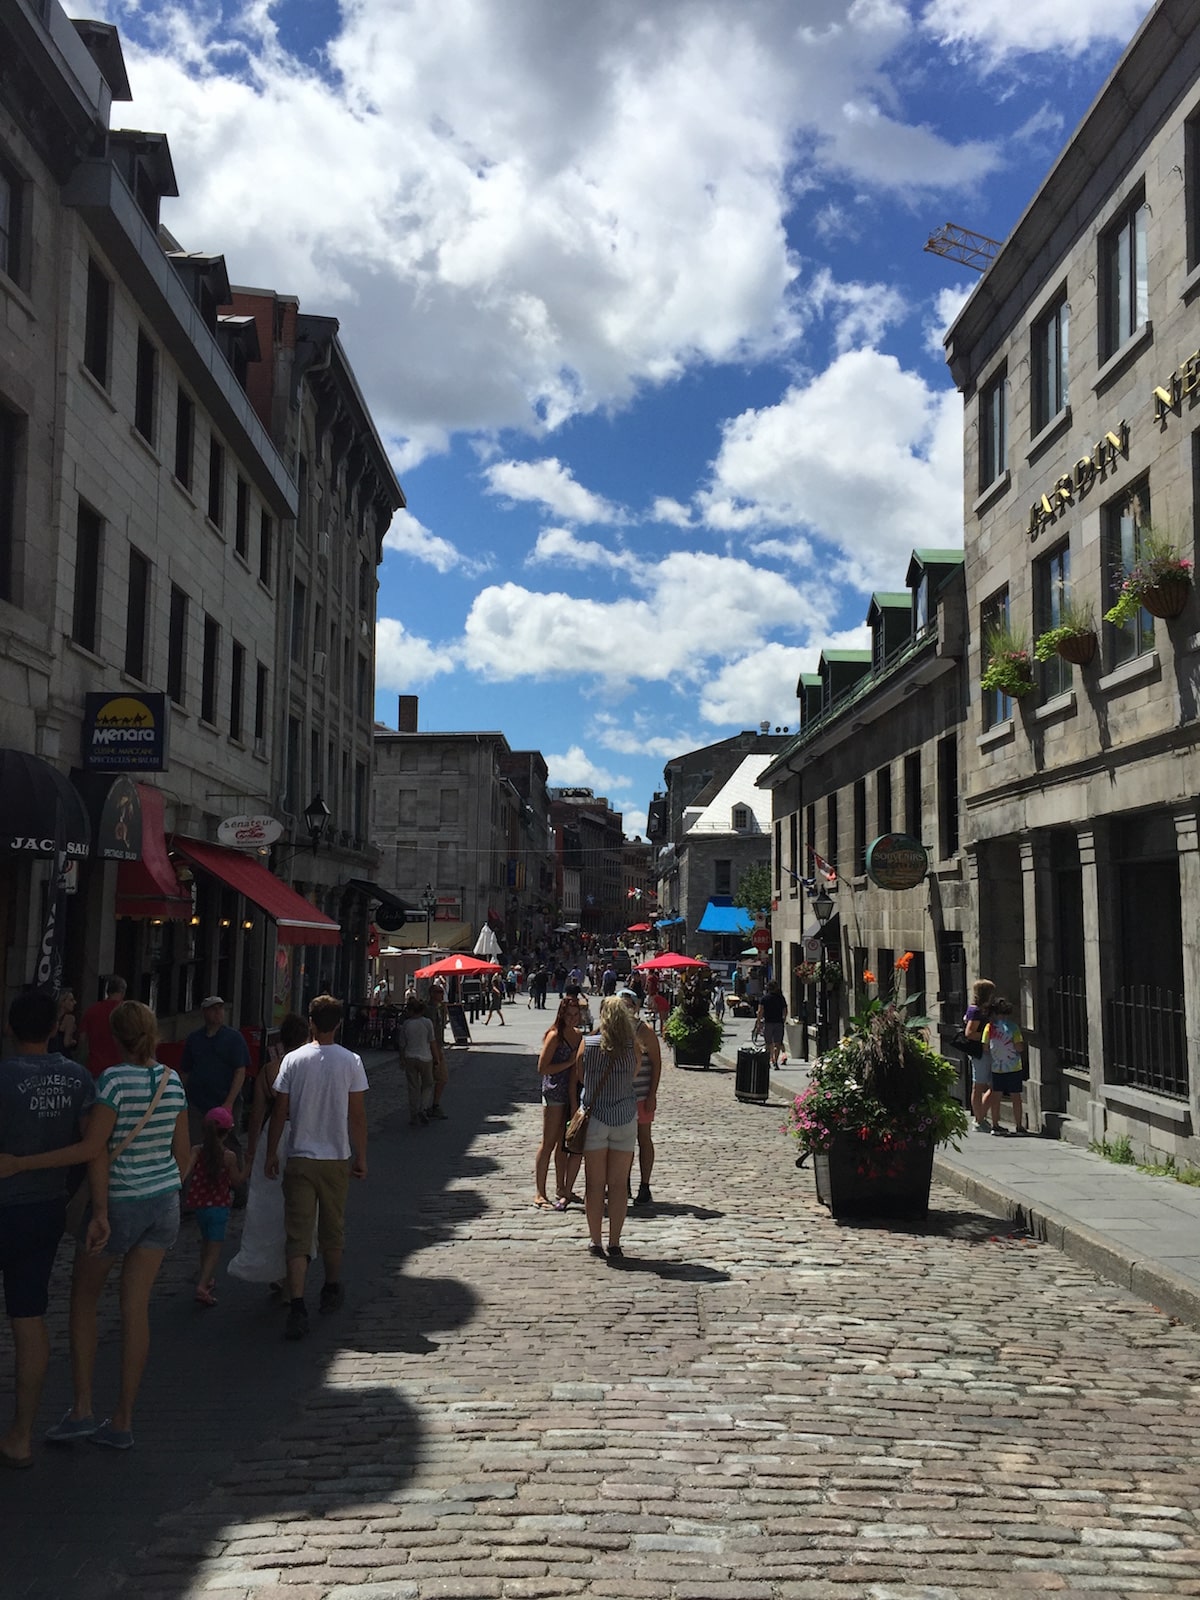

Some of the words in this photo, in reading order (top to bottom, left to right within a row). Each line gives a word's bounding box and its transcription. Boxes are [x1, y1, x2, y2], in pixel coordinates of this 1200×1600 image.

[1026, 419, 1126, 534] JARDIN
[92, 728, 155, 745] Menara
[30, 1096, 72, 1111] DENIM
